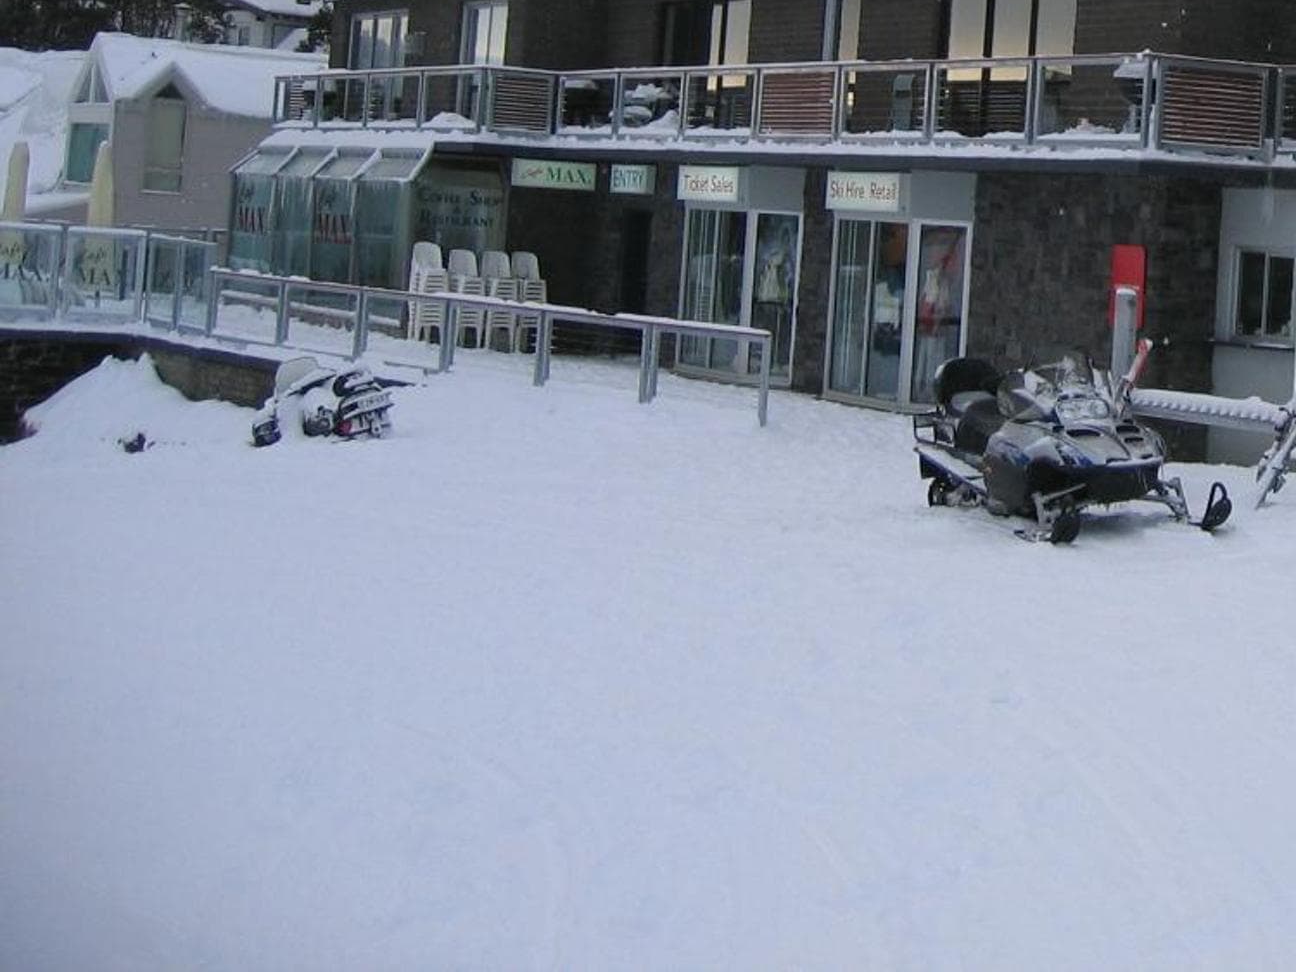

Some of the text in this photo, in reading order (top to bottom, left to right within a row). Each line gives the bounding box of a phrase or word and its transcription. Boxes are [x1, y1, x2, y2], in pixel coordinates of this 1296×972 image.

[612, 168, 645, 188] ENTRY
[684, 174, 734, 194] Ticket Sales
[831, 180, 897, 201] Ski Hire Retail
